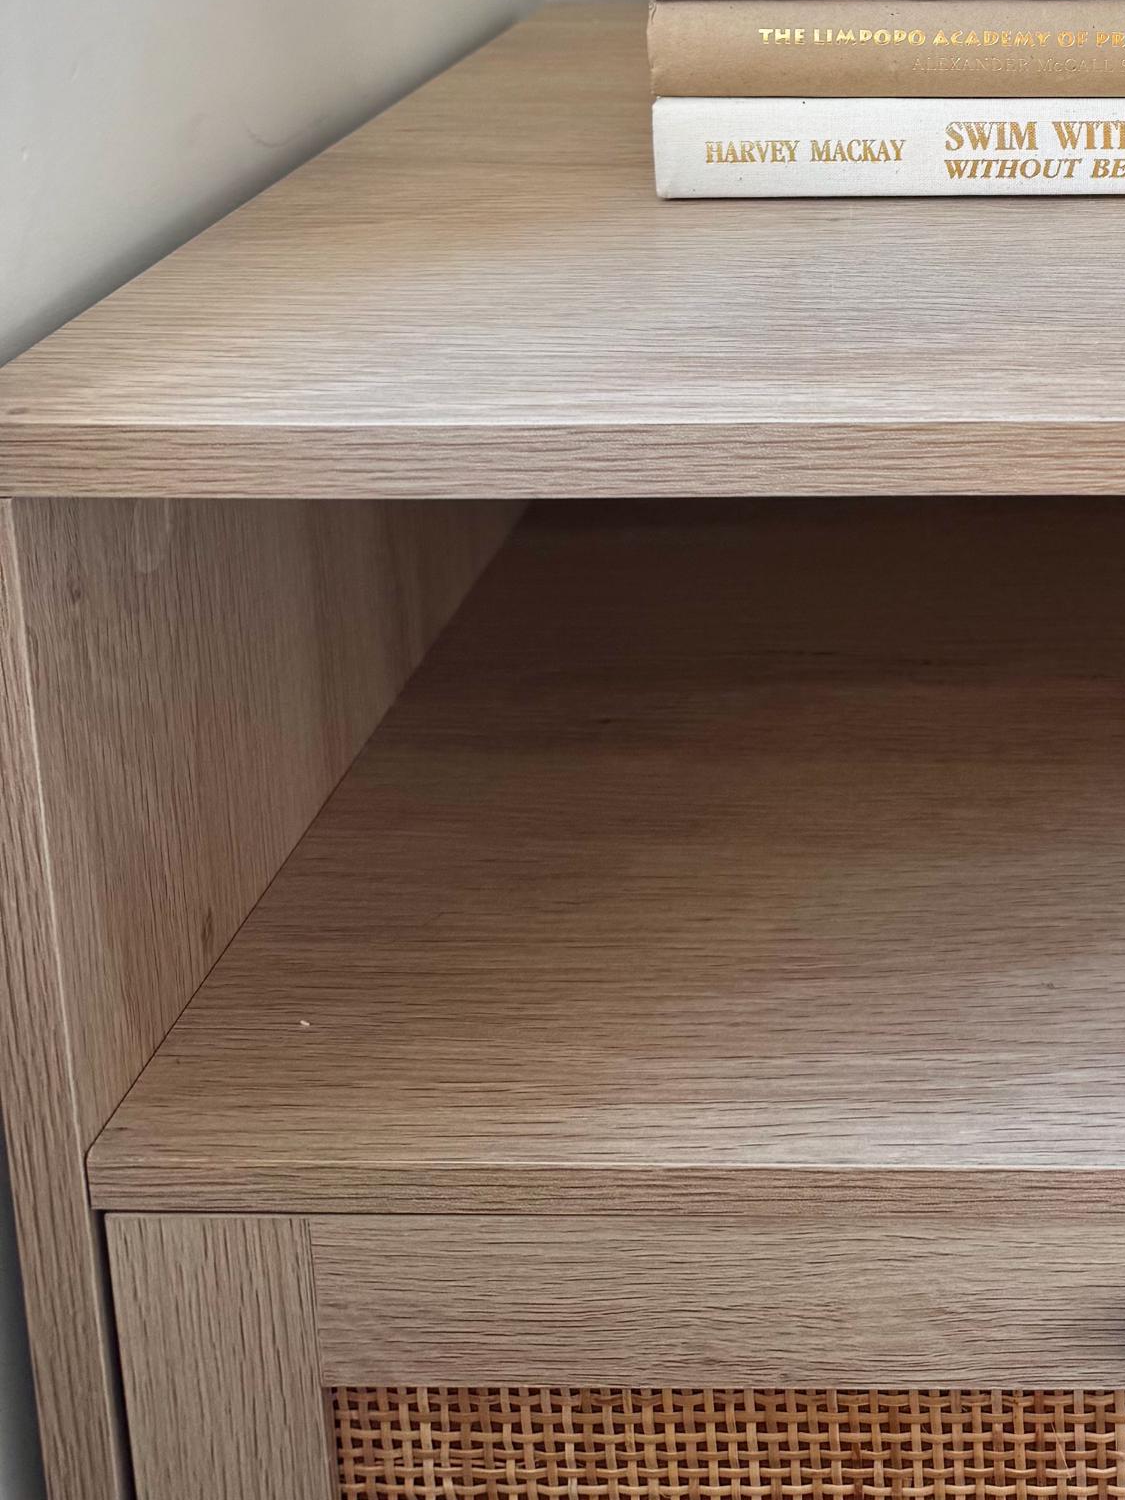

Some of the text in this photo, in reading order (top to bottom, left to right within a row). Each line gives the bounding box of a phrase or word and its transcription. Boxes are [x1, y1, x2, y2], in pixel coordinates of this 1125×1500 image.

[759, 28, 805, 45] THE
[813, 28, 926, 46] LIMPOPO
[933, 29, 1051, 47] ACADEMY
[1057, 30, 1088, 47] OF
[912, 57, 1029, 72] ALEXANDER
[945, 121, 1037, 152] SWIM
[705, 139, 906, 164] HARVEY MACKAY
[945, 159, 1086, 180] WITHOUT
